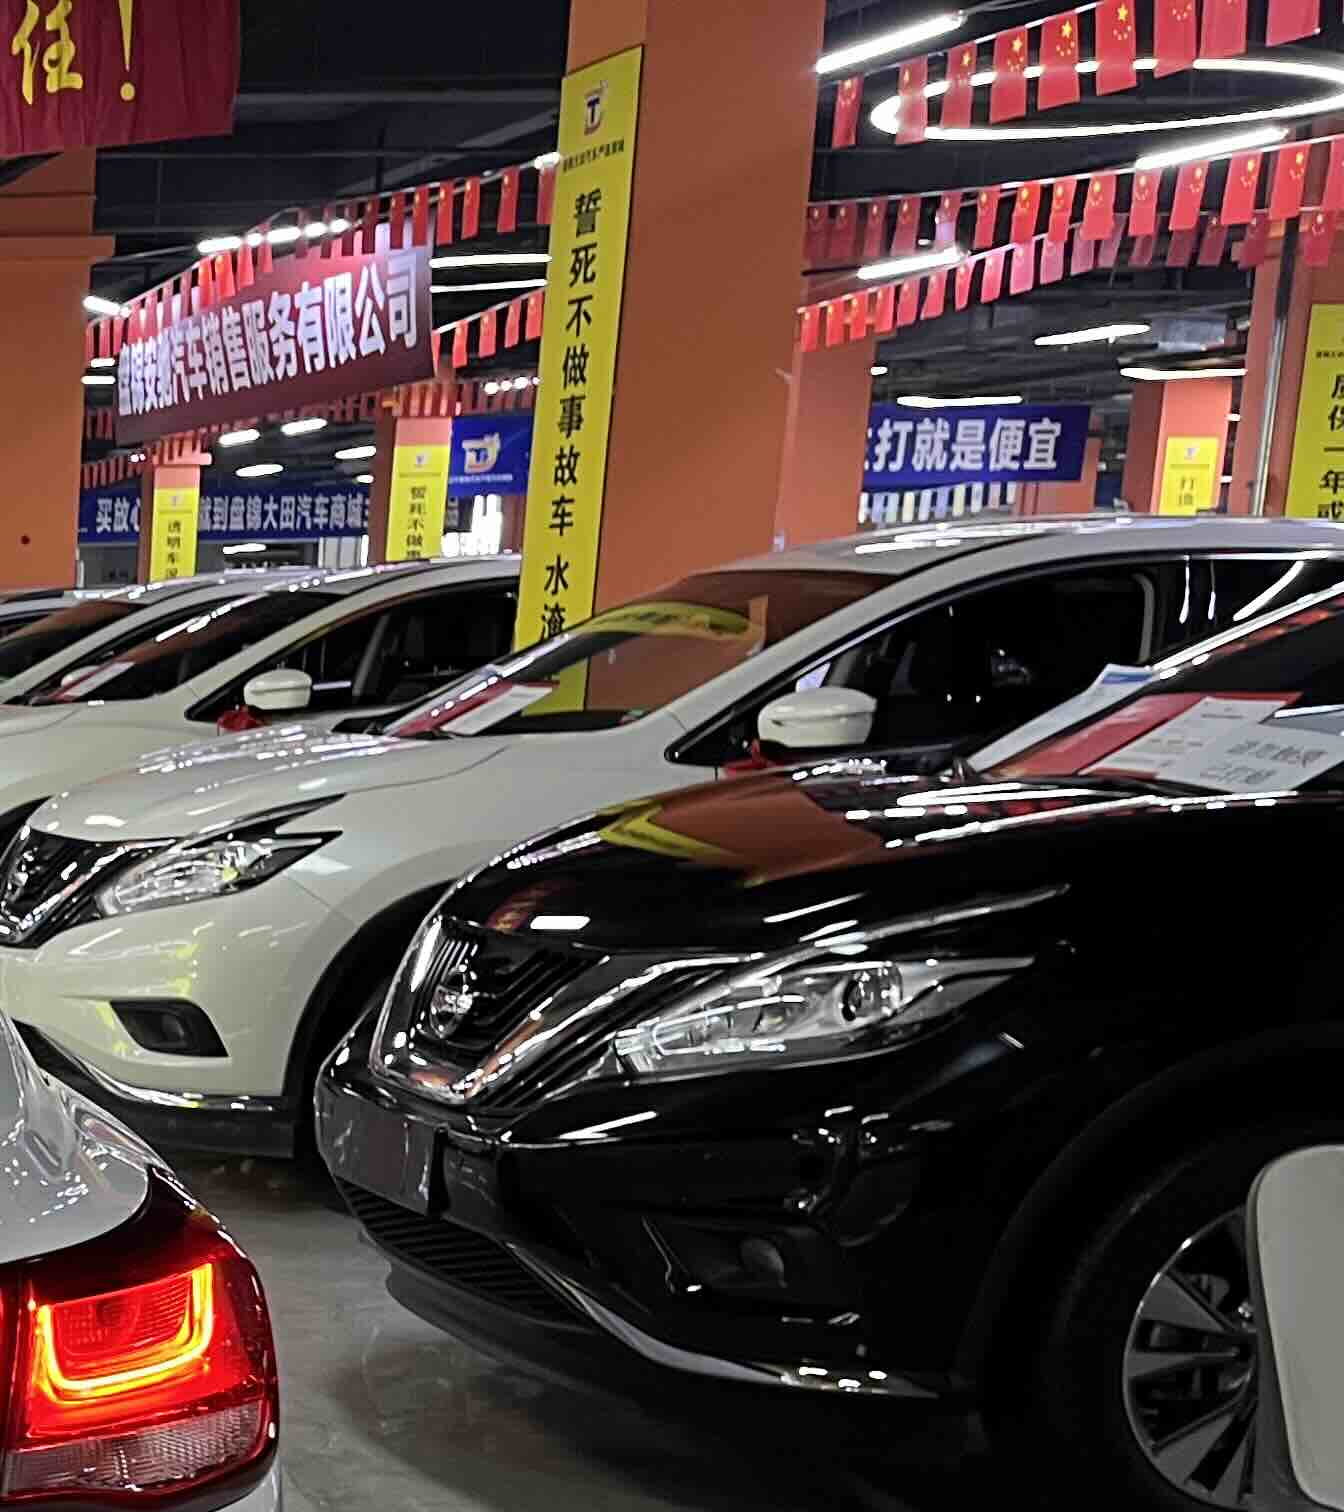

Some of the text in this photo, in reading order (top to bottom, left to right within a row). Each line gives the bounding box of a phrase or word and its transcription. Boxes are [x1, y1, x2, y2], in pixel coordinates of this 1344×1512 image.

[550, 188, 601, 537] 誓死不做事故车
[864, 417, 1062, 473] 打就是便宜
[199, 492, 369, 531] 就到盘锦大田汽车商城
